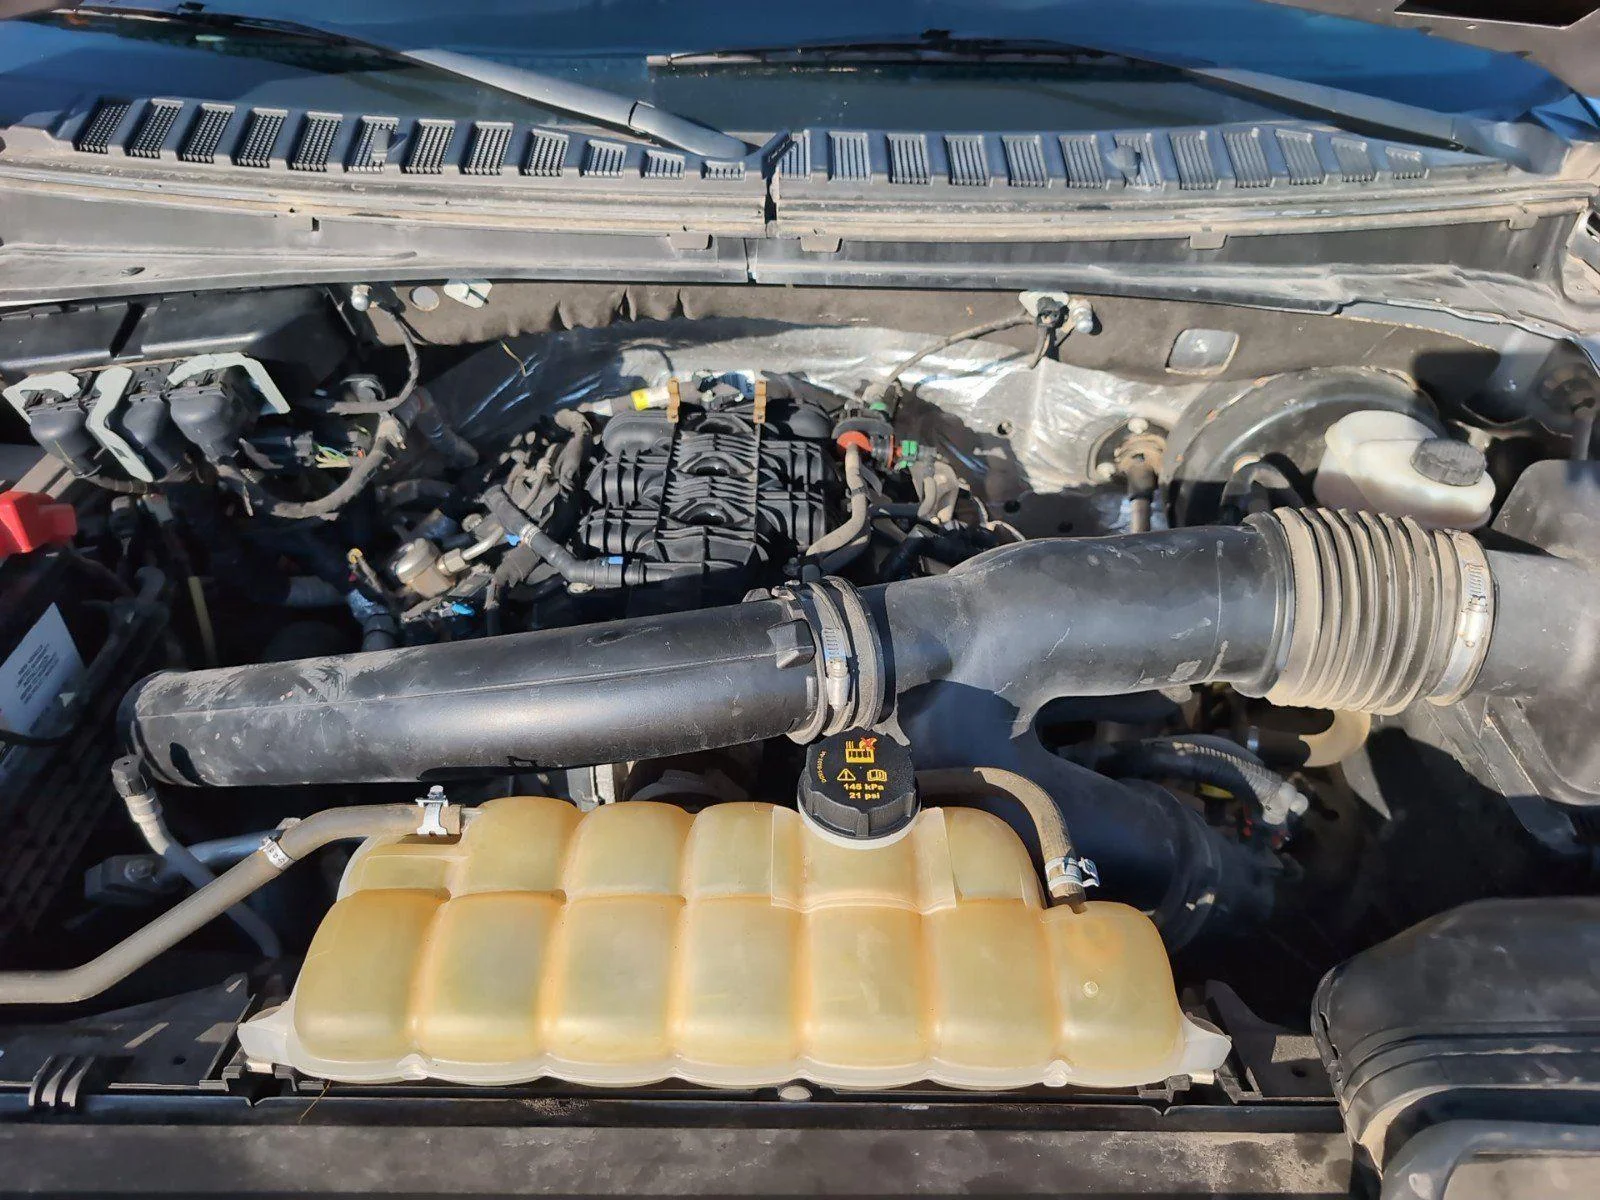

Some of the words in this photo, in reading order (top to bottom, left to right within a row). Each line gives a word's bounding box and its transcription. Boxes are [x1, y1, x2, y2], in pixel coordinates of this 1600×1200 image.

[843, 783, 862, 791] 145
[864, 783, 885, 791] kPa
[864, 792, 881, 800] psi
